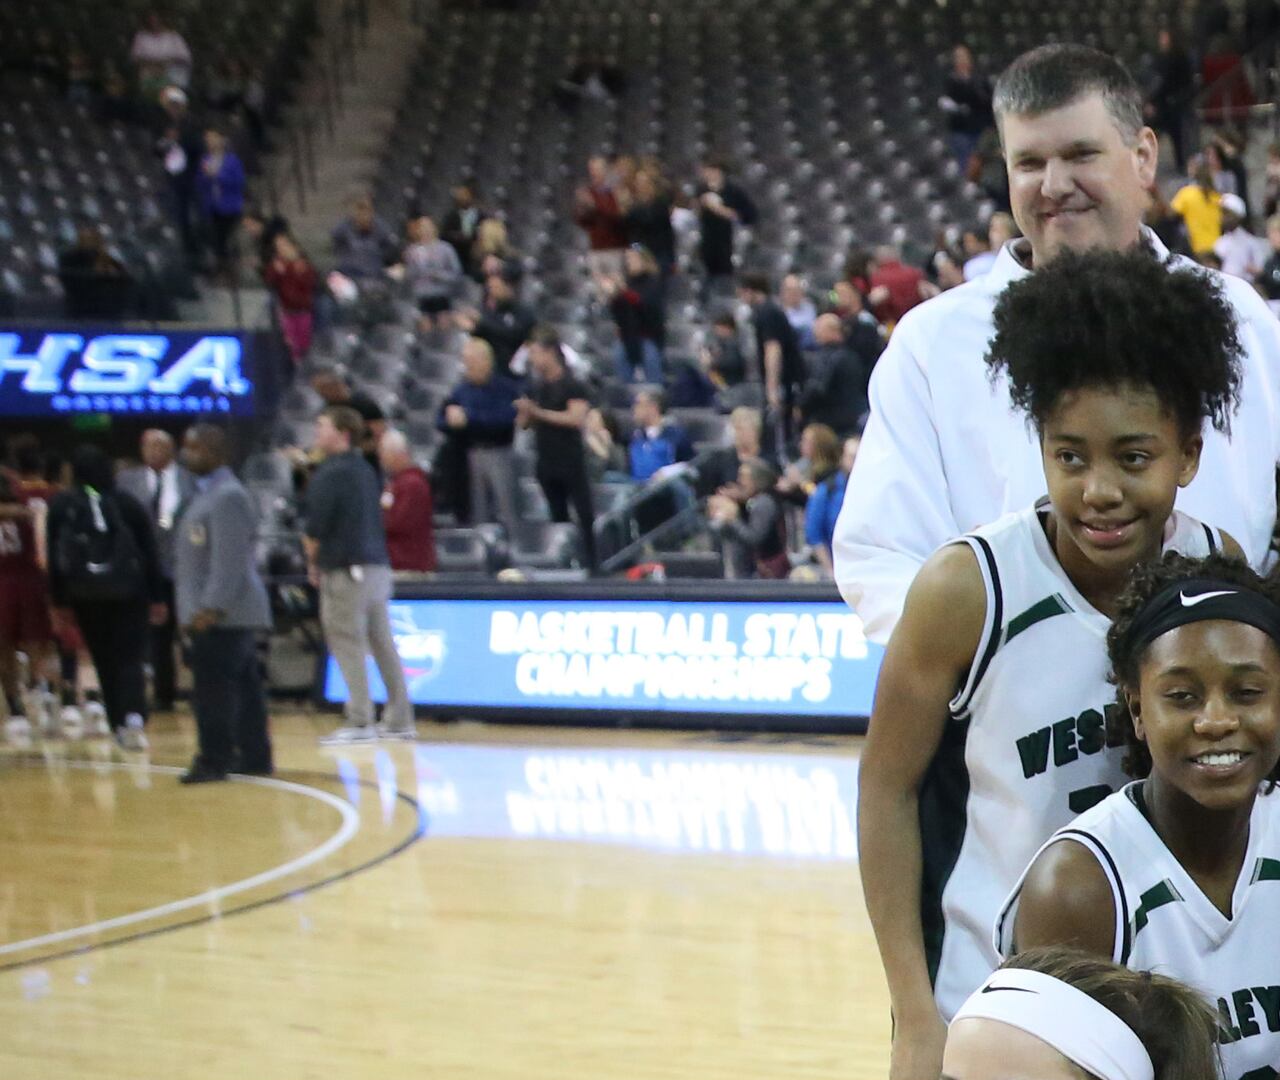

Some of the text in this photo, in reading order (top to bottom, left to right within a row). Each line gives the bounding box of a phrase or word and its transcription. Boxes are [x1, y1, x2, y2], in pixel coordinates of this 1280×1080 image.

[490, 611, 737, 657] BASKETBALL
[743, 613, 869, 660] STATE
[515, 653, 833, 702] CHAMPIONSHIPS
